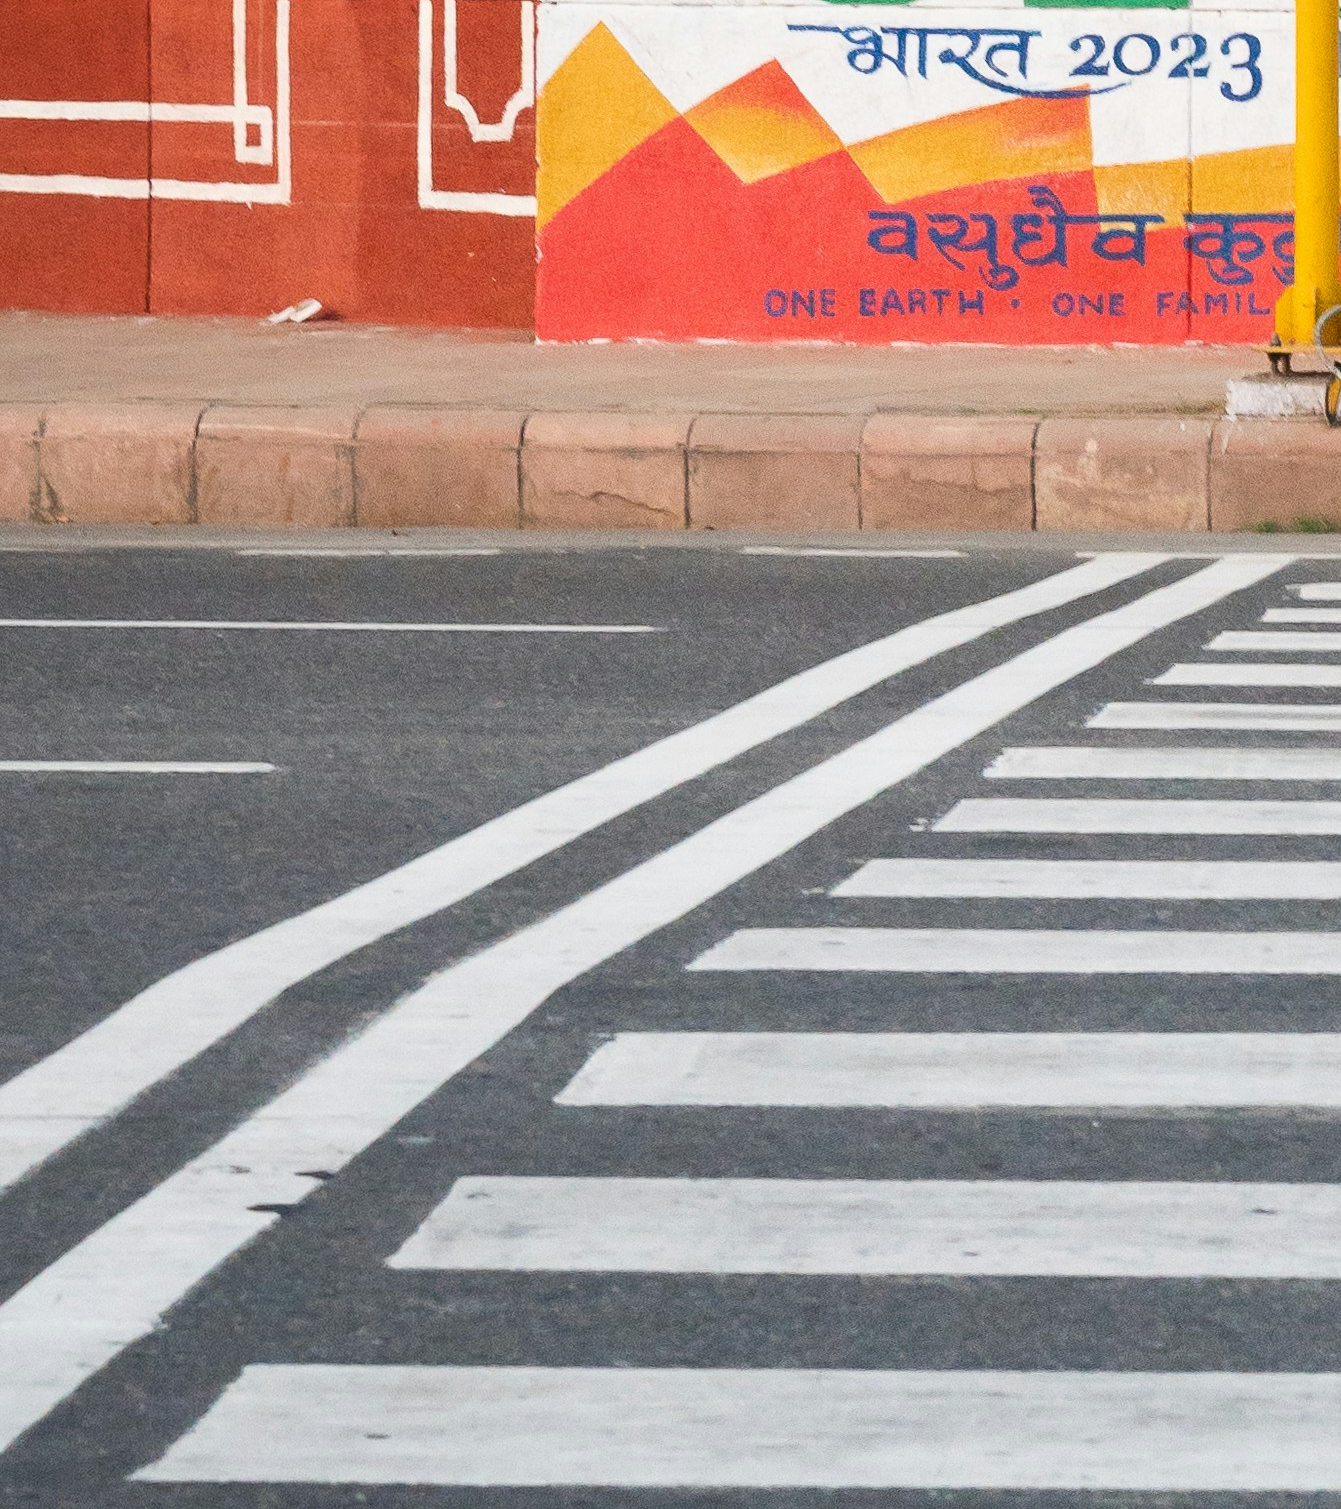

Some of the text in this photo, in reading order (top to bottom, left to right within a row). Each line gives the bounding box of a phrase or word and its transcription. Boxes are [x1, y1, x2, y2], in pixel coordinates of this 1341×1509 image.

[787, 24, 1131, 99] भारत
[1069, 32, 1262, 102] 2023
[866, 186, 1165, 290] वसुधैव
[764, 289, 836, 318] ONE
[859, 289, 984, 316] EARTH
[1052, 293, 1126, 317] ONE
[1157, 291, 1271, 316] FAMIL
